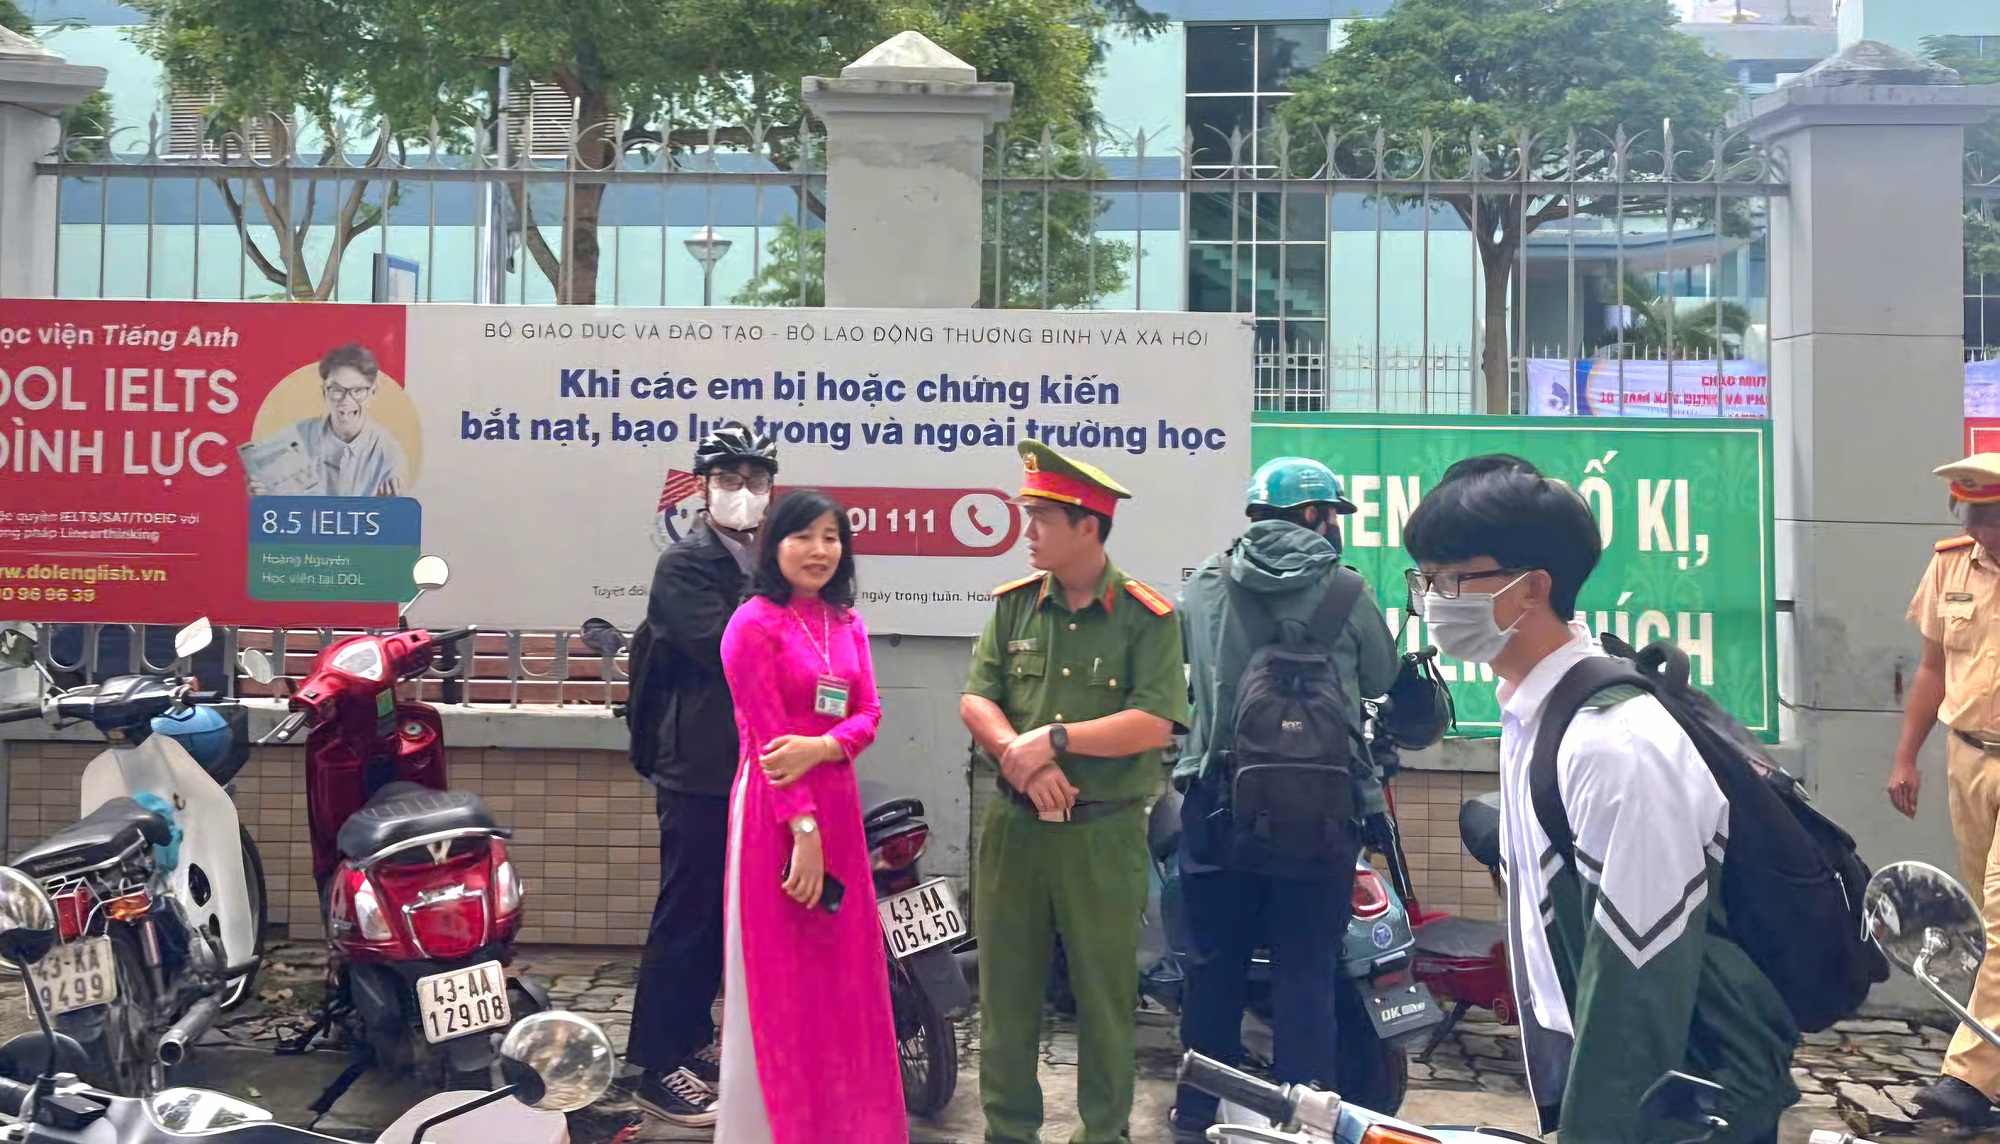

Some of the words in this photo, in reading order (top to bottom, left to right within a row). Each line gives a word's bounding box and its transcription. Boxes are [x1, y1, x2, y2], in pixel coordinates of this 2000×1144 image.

[0, 327, 32, 350] ọc
[38, 322, 94, 350] viện
[102, 323, 178, 351] Tiếng
[182, 325, 240, 348] Anh
[721, 324, 764, 343] TẠO
[824, 325, 865, 342] LAO
[0, 364, 87, 411] OL
[104, 367, 240, 415] IELTS
[560, 368, 621, 399] Khi
[630, 370, 699, 401] các
[707, 376, 764, 401] em
[773, 369, 806, 408] bị
[816, 371, 907, 408] hoặc
[916, 373, 1030, 410] chứng
[1040, 373, 1120, 405] kiến
[461, 406, 520, 441] bắt
[530, 412, 601, 448] nạt,
[611, 411, 679, 448] bạo
[753, 414, 851, 451] trong
[861, 416, 904, 446] và
[914, 415, 1016, 453] ngoài
[1024, 417, 1148, 455] trường
[1157, 418, 1227, 456] học
[0, 416, 104, 474] ÌNH
[123, 427, 230, 486] LỰC
[261, 508, 302, 534] 8.5
[311, 509, 381, 537] IELTS
[846, 507, 877, 537] ỌI
[886, 508, 935, 533] 111
[1637, 478, 1710, 571] KỊ,
[0, 564, 167, 584] w.dolenglish.vn
[337, 573, 366, 586] DOL
[894, 590, 929, 605] trong
[892, 909, 960, 953] 054.50
[433, 967, 493, 1005] 43-AA
[429, 995, 505, 1037] 129.08
